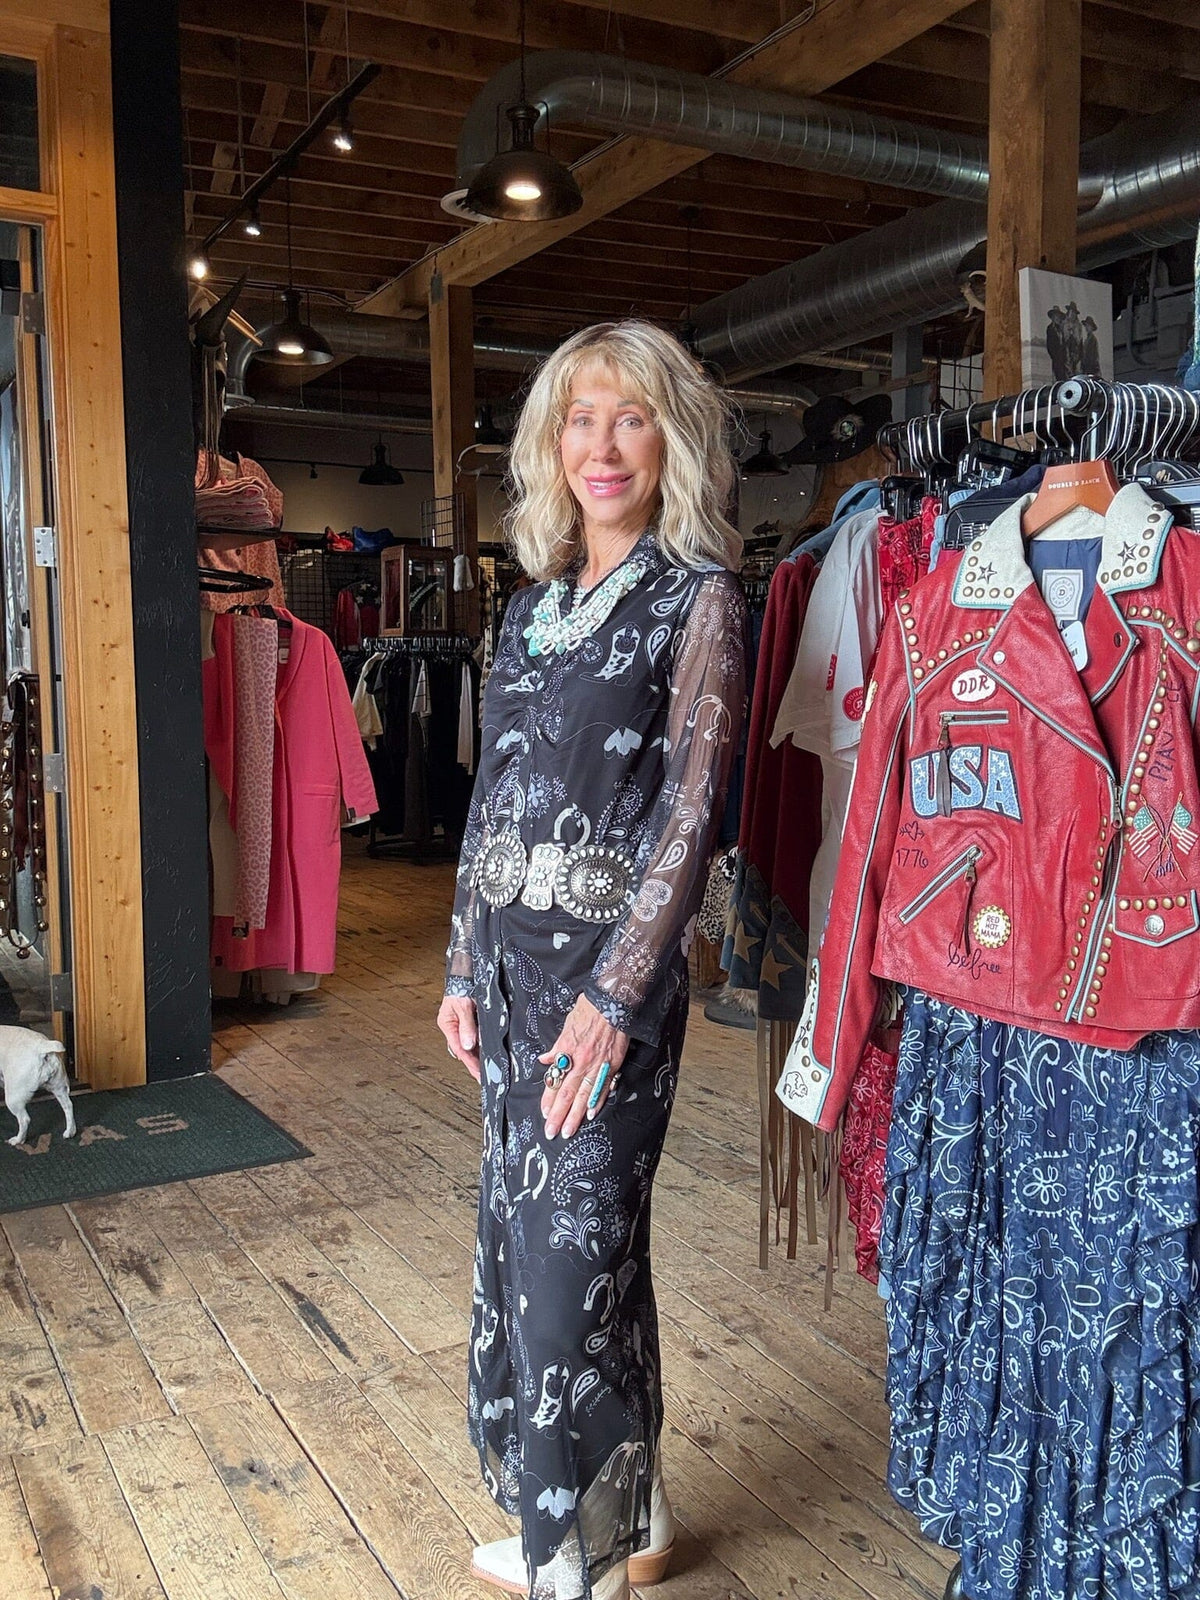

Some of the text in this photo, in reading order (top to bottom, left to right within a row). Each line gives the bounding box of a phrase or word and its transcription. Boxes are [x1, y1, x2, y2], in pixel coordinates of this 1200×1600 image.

[957, 675, 990, 696] DDR
[908, 746, 1021, 821] USA
[896, 848, 929, 868] 1776
[985, 922, 998, 930] HOT
[987, 915, 1000, 923] RED
[981, 929, 1000, 939] MAMA
